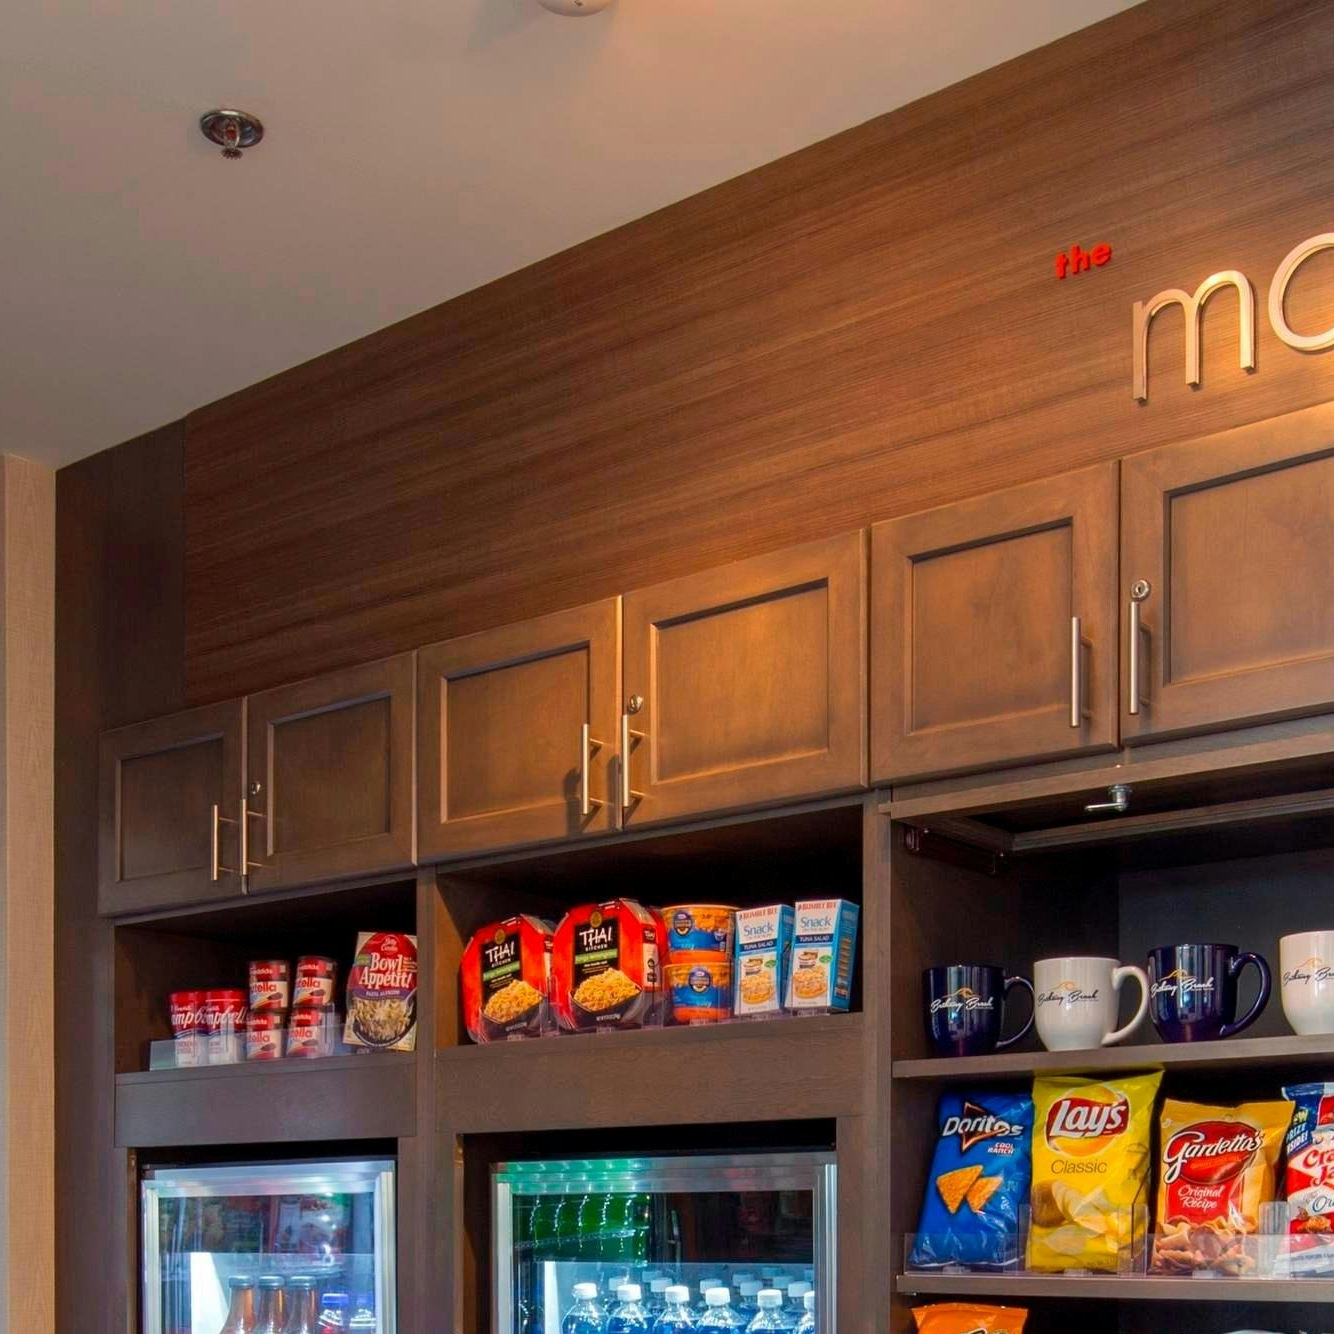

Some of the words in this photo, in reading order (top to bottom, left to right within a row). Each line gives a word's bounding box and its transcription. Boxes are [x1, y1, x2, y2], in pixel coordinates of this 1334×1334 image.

[1055, 242, 1113, 280] the
[744, 922, 775, 937] Snack
[800, 916, 832, 928] Snack
[579, 926, 613, 947] THAI
[370, 952, 404, 972] Bowl
[485, 941, 516, 963] THAI
[942, 1114, 1024, 1138] Doritos
[1049, 1099, 1128, 1138] Lay's
[1163, 1127, 1265, 1185] Gardetto's
[1051, 1158, 1108, 1175] Classic
[1177, 1185, 1225, 1200] Original
[1182, 1198, 1219, 1211] Recipe
